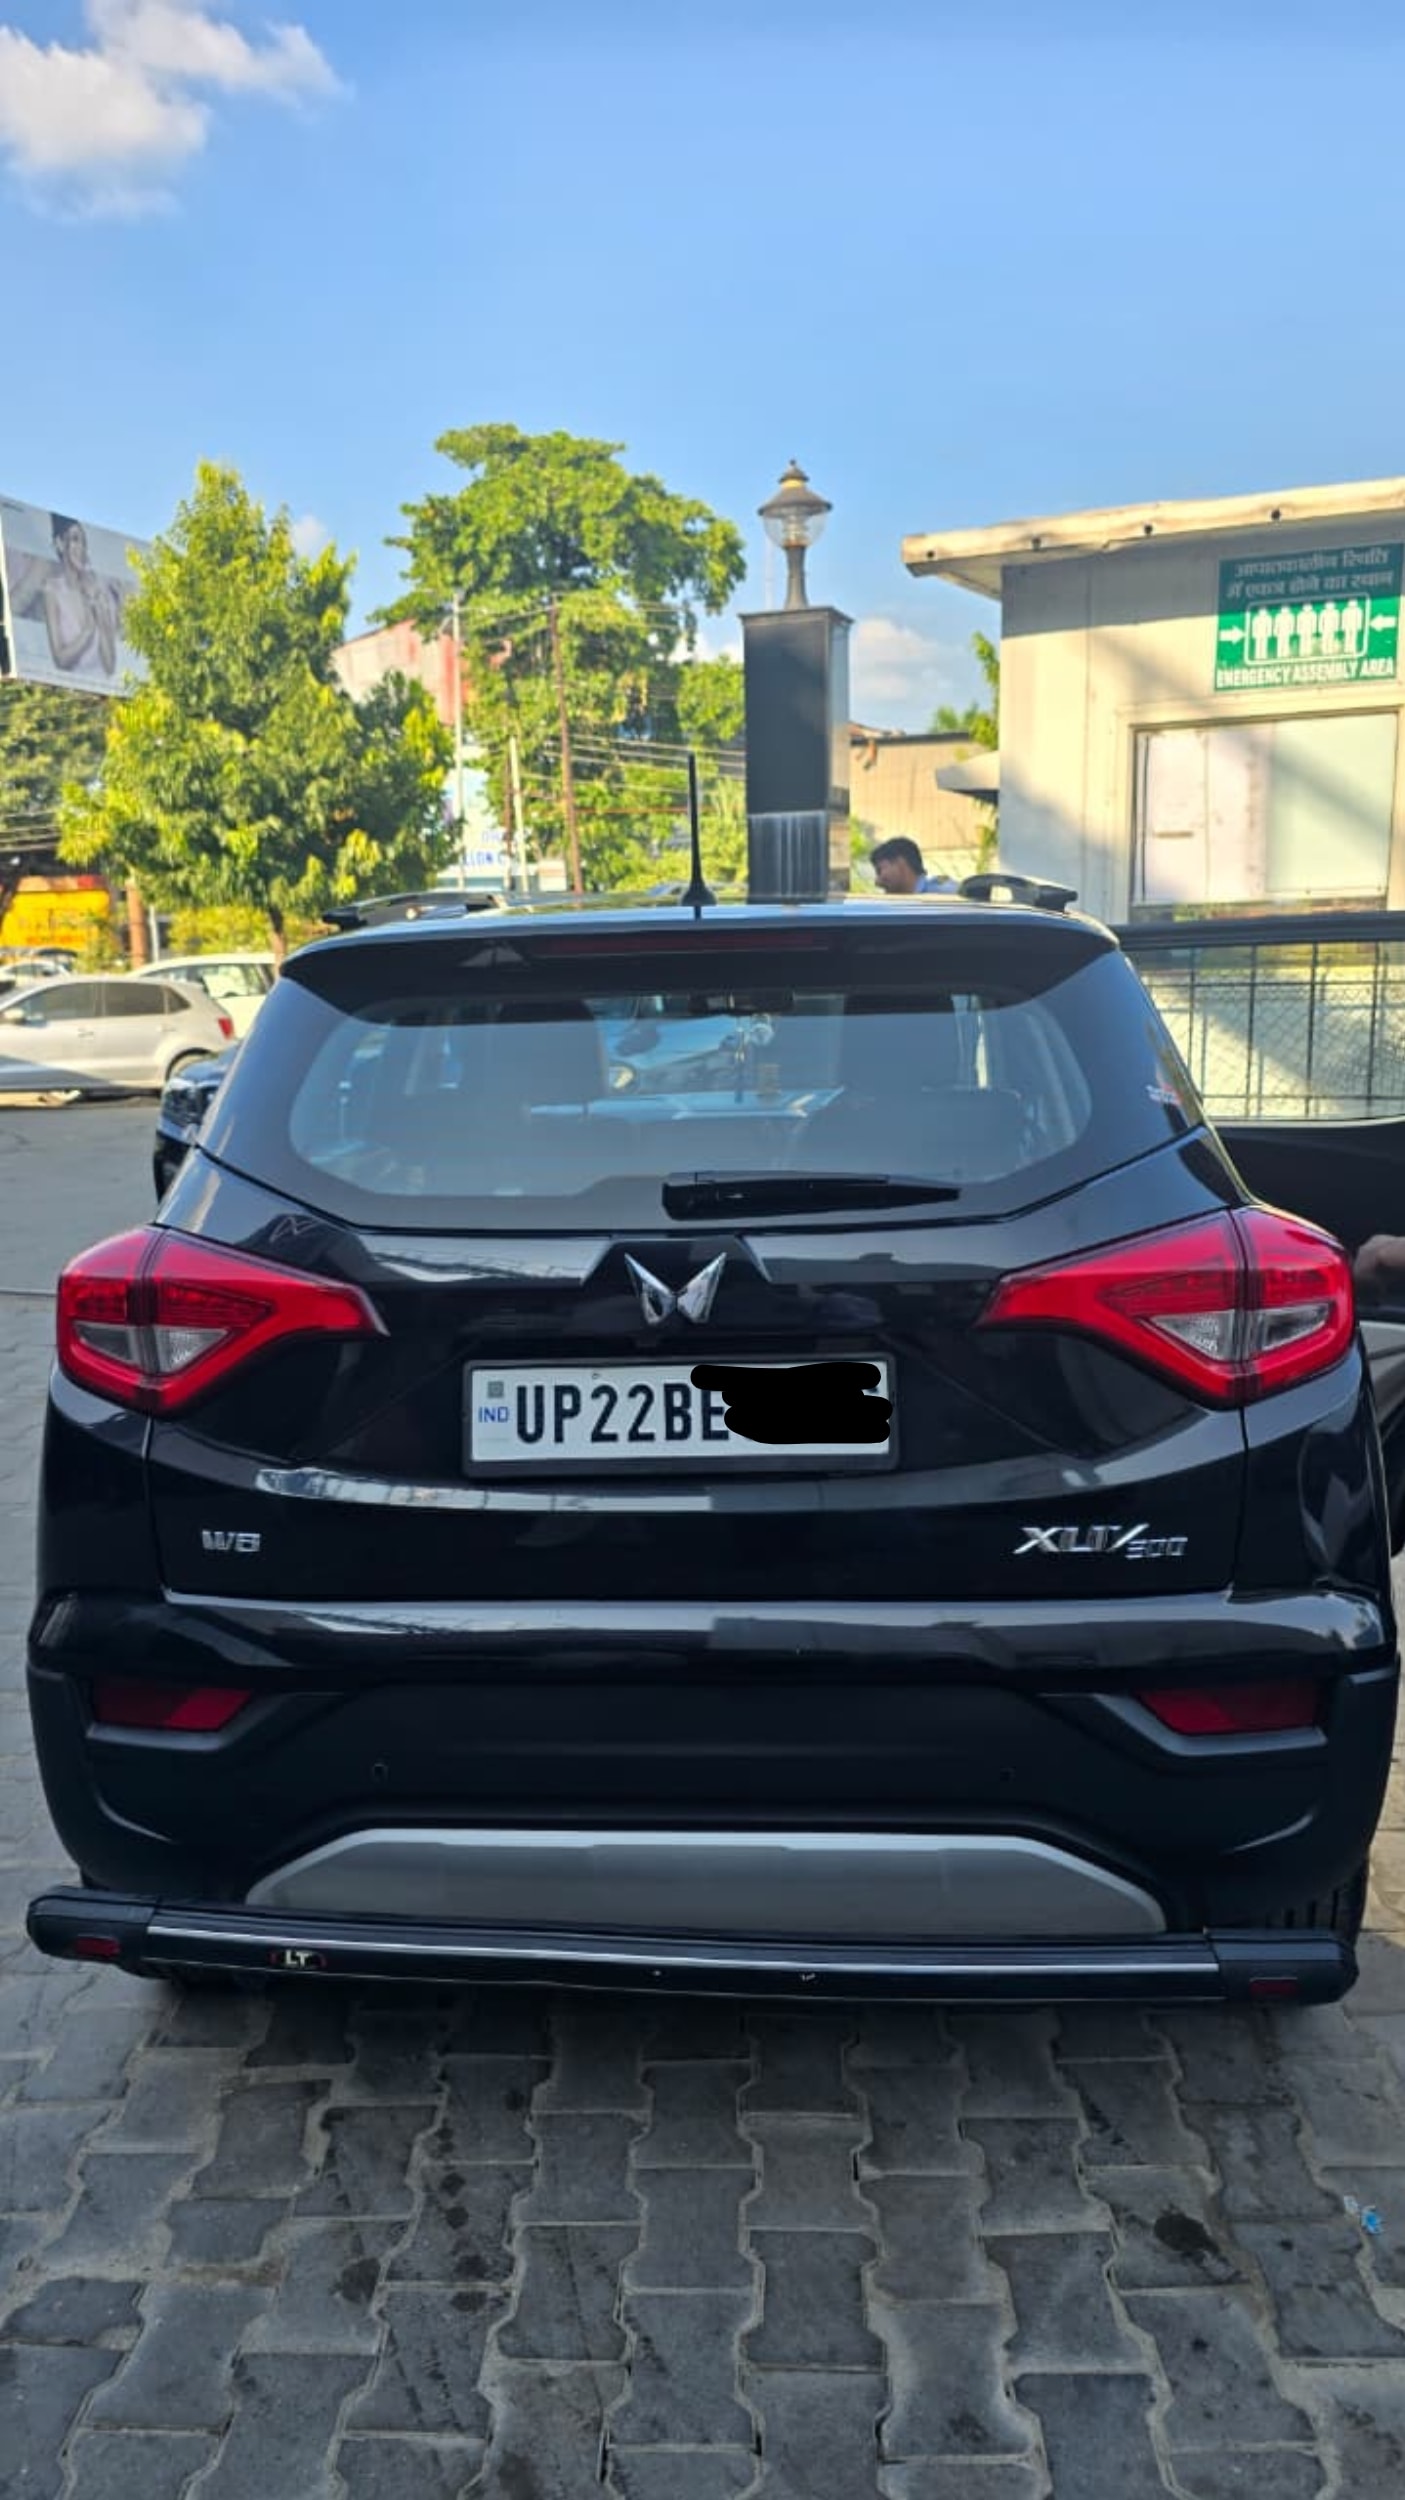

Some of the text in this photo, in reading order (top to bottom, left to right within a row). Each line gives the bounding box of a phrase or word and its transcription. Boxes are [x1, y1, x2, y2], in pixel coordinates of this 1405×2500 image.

[1217, 658, 1394, 688] EMERGENCY ASSEMBLY AREA
[479, 1407, 509, 1423] IND
[517, 1383, 878, 1444] UP22BE
[285, 1949, 311, 1966] LT
